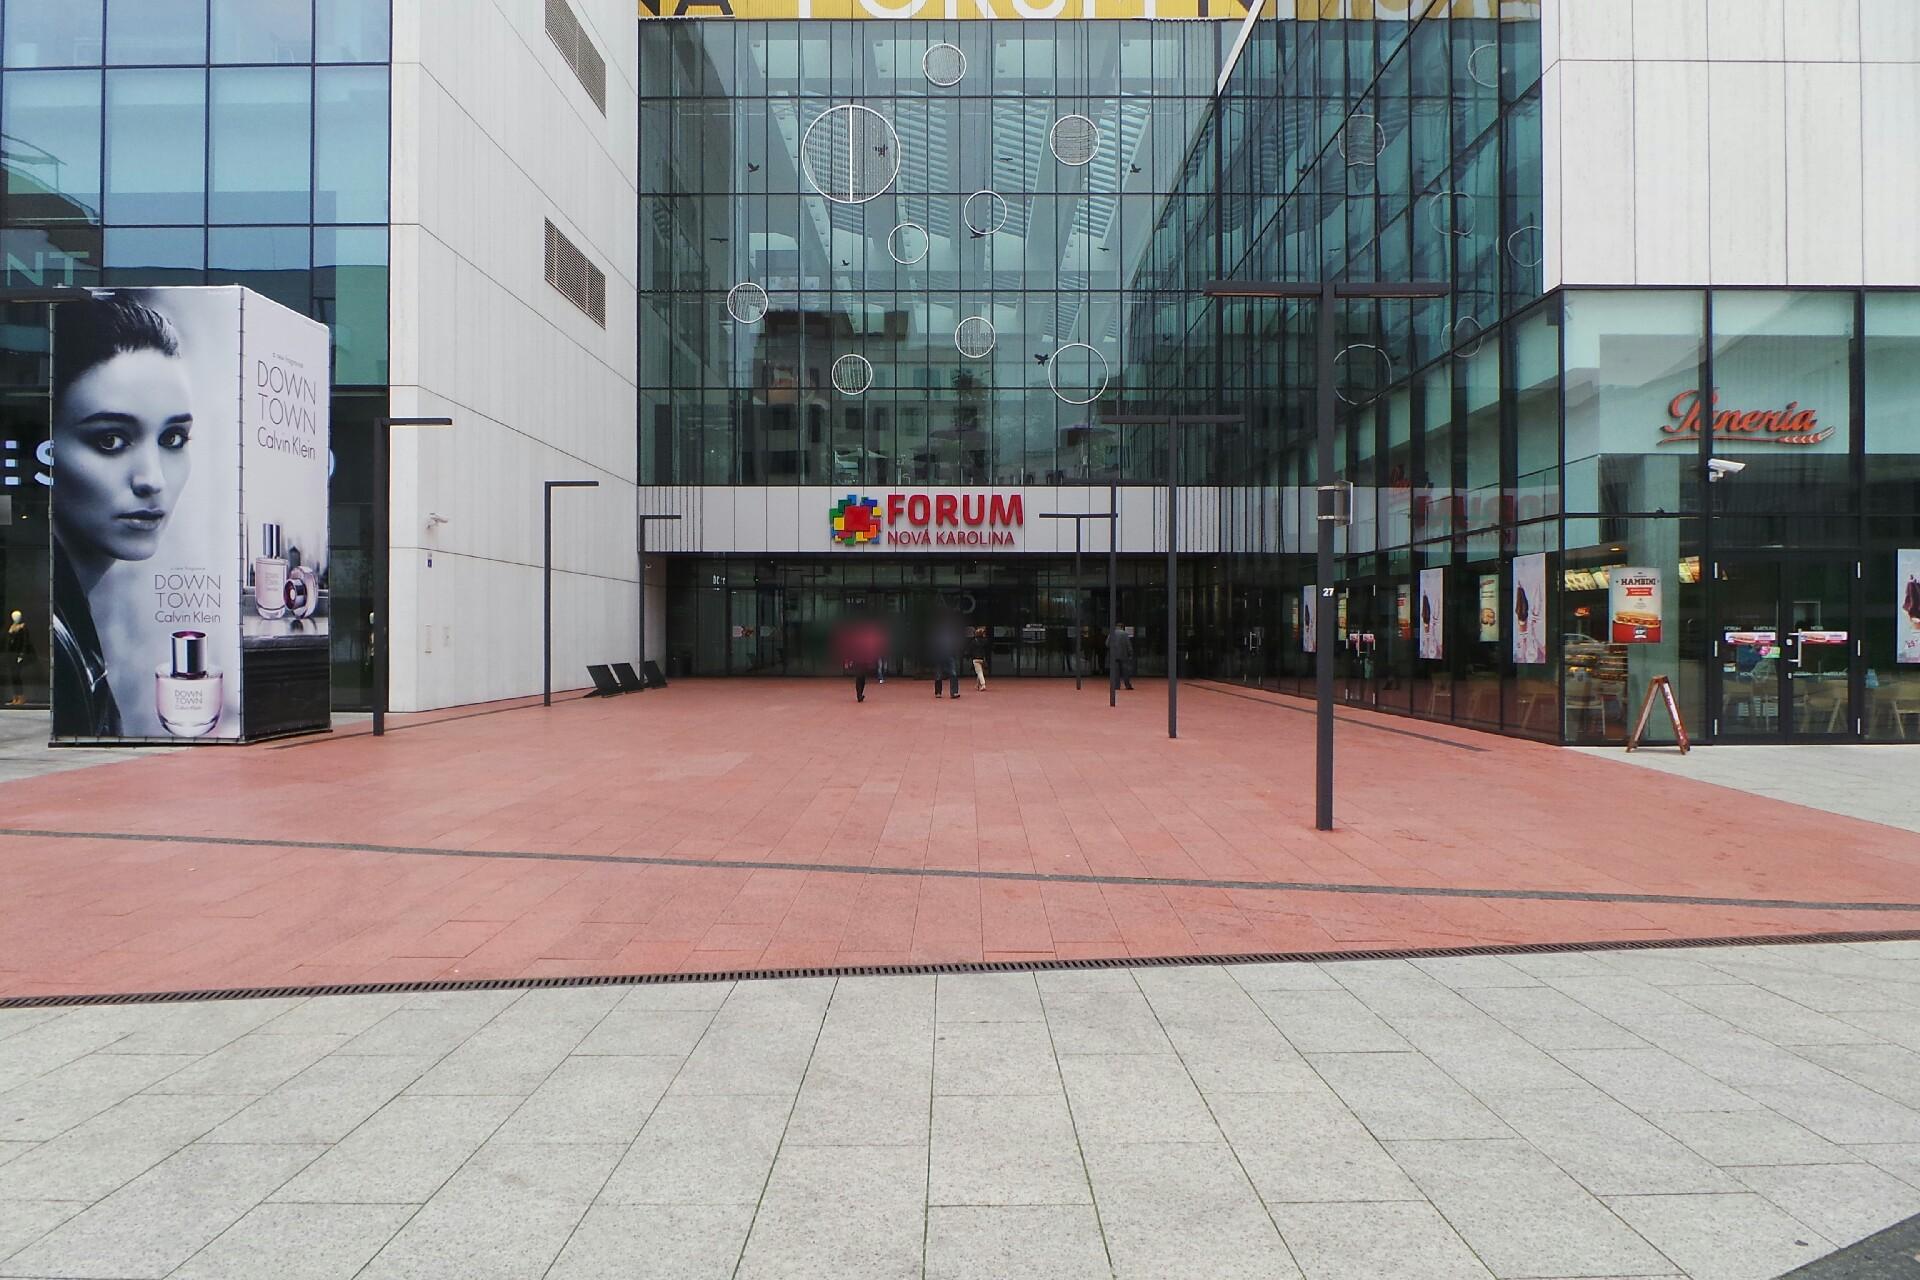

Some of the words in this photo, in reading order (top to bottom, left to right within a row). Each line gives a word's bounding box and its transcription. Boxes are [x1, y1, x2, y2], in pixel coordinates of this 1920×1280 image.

[257, 360, 316, 405] DOWN
[257, 392, 316, 436] TOWN
[257, 426, 291, 454] Calvin
[292, 435, 316, 460] Klein
[887, 494, 1024, 526] FORUM
[887, 529, 931, 545] NOVÁ
[936, 531, 1015, 545] KAROLINA
[154, 574, 221, 590] DOWN
[155, 592, 221, 609] TOWN
[1322, 587, 1335, 597] 27
[155, 610, 191, 623] Calvin
[193, 611, 221, 623] Klein
